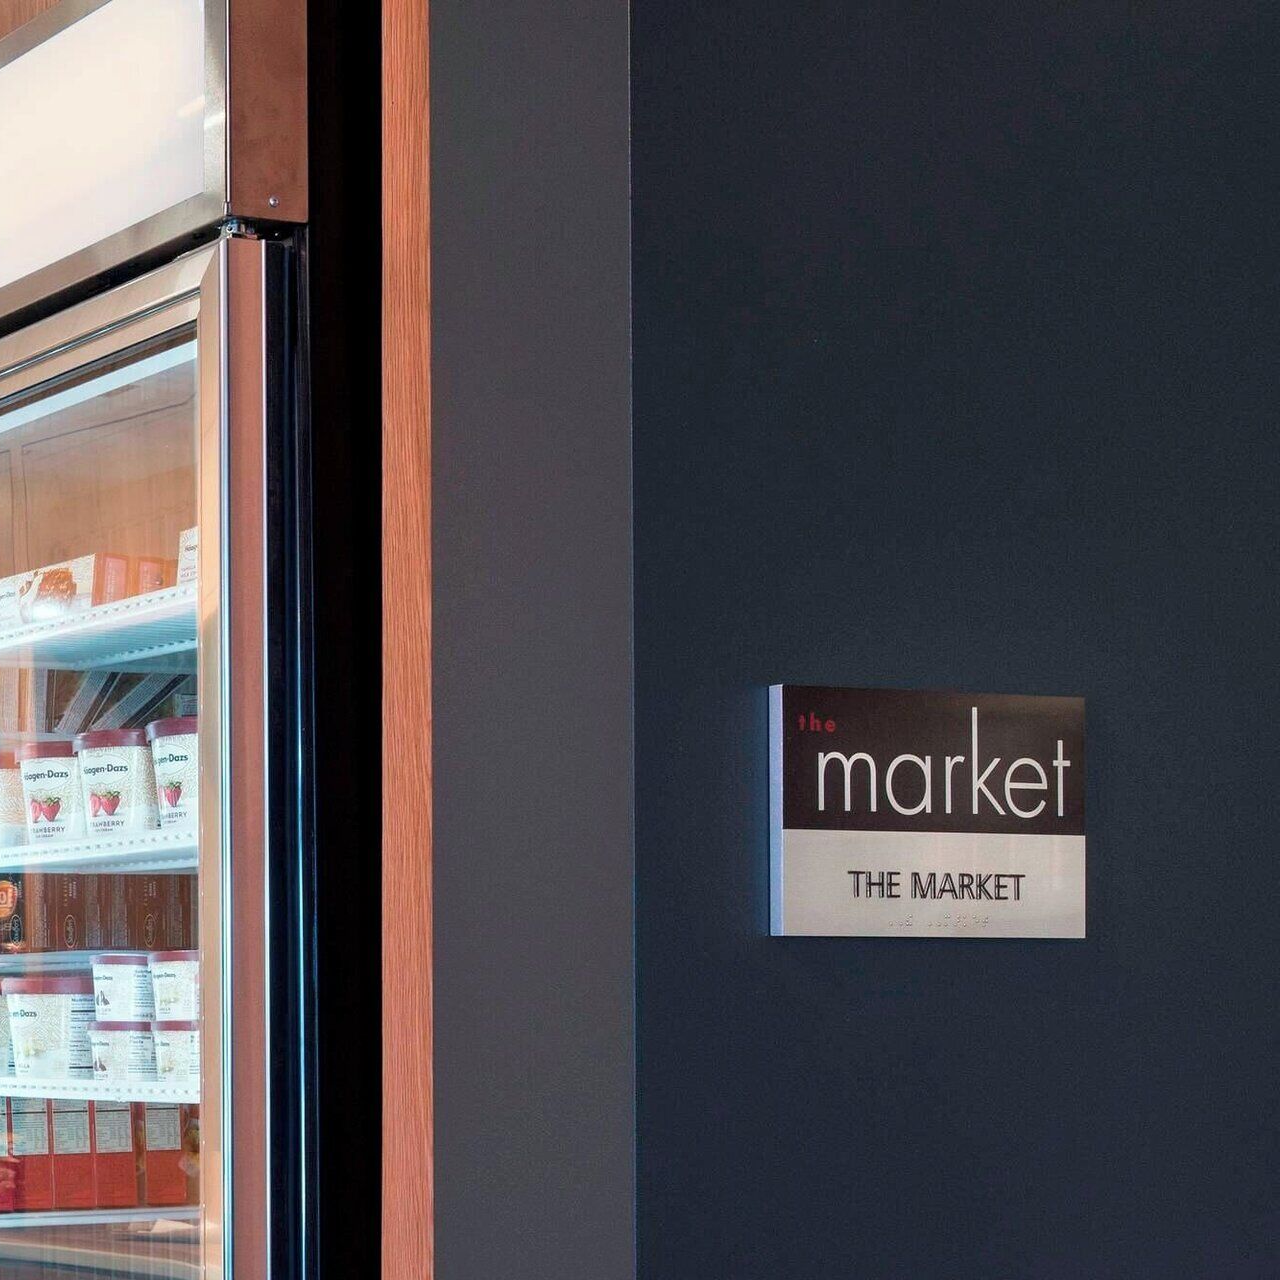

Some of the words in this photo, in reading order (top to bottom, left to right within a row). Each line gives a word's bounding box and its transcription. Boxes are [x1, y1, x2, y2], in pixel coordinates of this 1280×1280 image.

[797, 711, 837, 734] the
[817, 706, 1071, 819] market
[848, 870, 901, 899] THE
[911, 872, 1026, 901] MARKET
